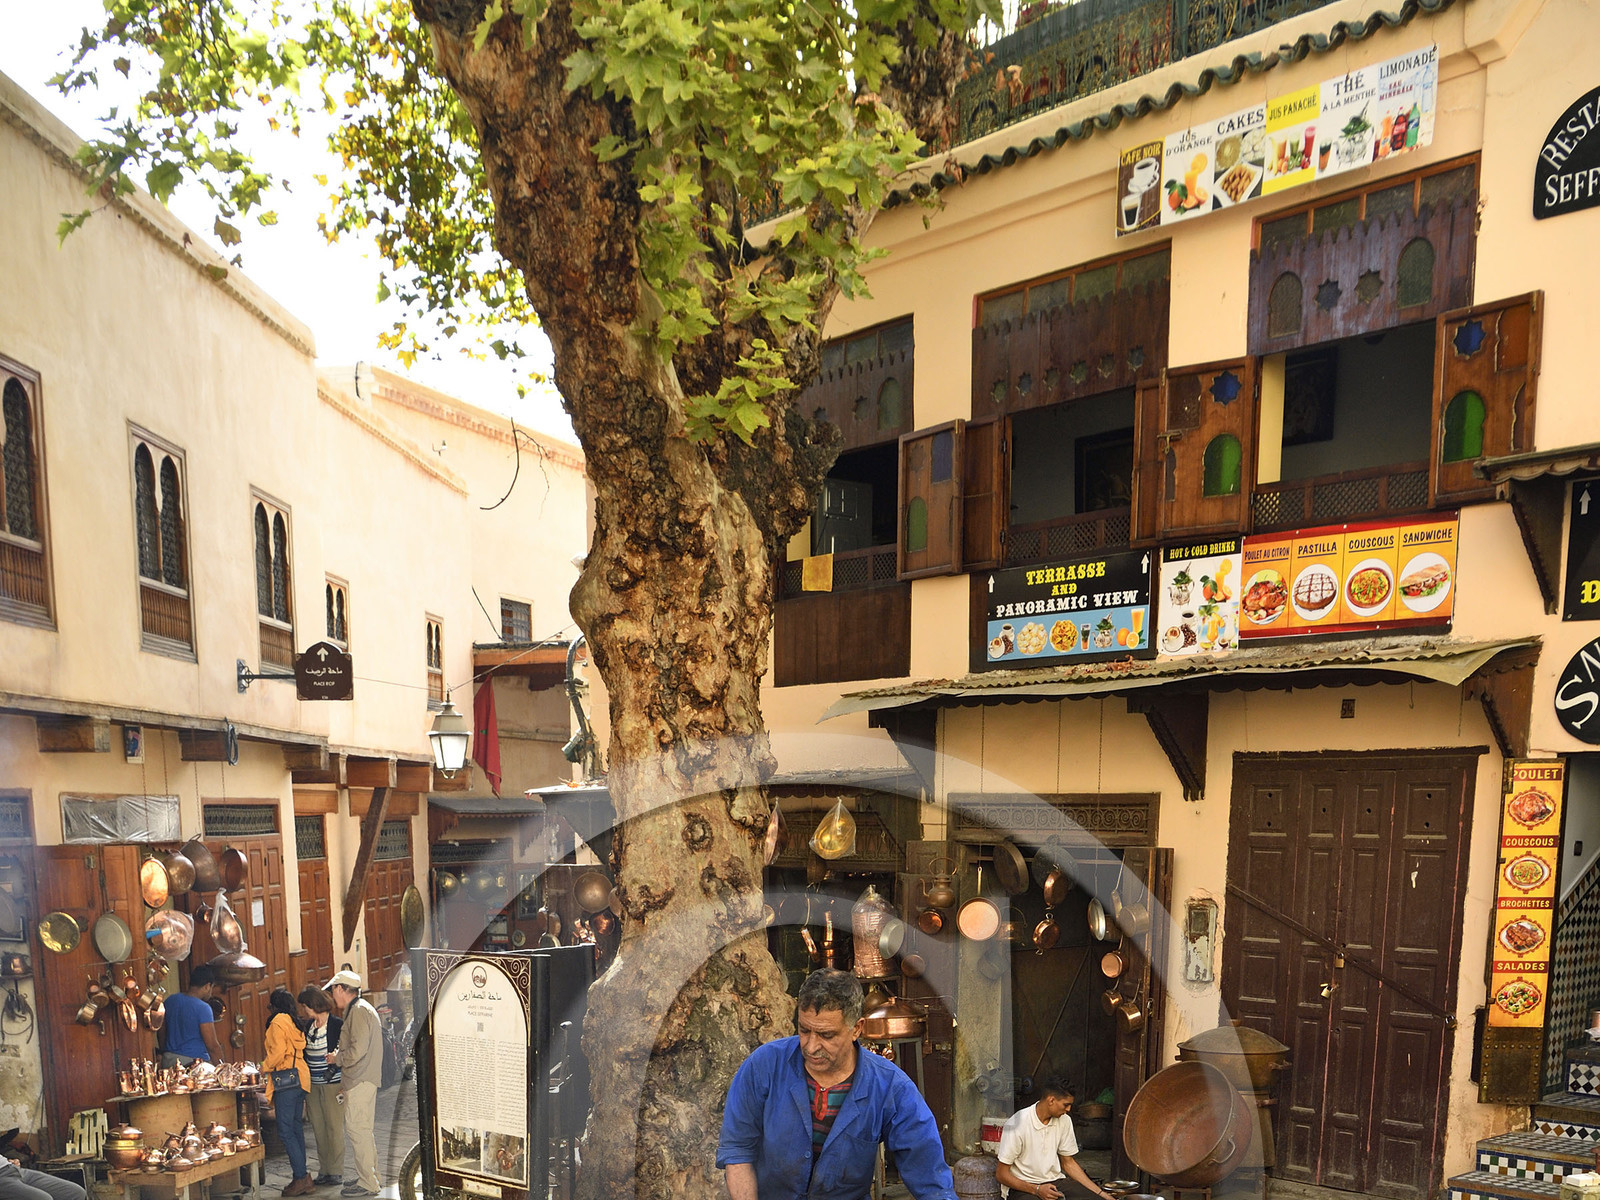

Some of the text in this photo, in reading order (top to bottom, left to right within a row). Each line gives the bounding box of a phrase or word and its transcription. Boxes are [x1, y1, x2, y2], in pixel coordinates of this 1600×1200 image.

[1380, 50, 1436, 79] LIMONADE
[1330, 100, 1341, 110] LA
[1343, 87, 1377, 105] MENTHE
[1269, 93, 1317, 121] JUS PANACHÉ
[1217, 110, 1265, 135] CAKES
[1165, 135, 1213, 157] D'ORANGE
[1179, 132, 1197, 144] JUS
[1143, 142, 1161, 160] NOIR
[1544, 166, 1600, 208] SEFF
[1348, 535, 1395, 550] COUSCOUS
[1402, 528, 1453, 543] SANDWICHE
[1169, 541, 1236, 560] HOT & COLD DRINKS
[1245, 546, 1290, 560] POULET AU CITRON
[1297, 541, 1338, 555] PASTILLA
[1026, 561, 1106, 586] TERRASSE
[1051, 583, 1078, 597] AND
[996, 589, 1139, 618] PANORAMIC VIEW
[1513, 768, 1559, 781] POULET
[1505, 837, 1554, 847] COUSCOUS
[1500, 900, 1550, 908] BROCHETTES
[1496, 962, 1546, 971] SALADES
